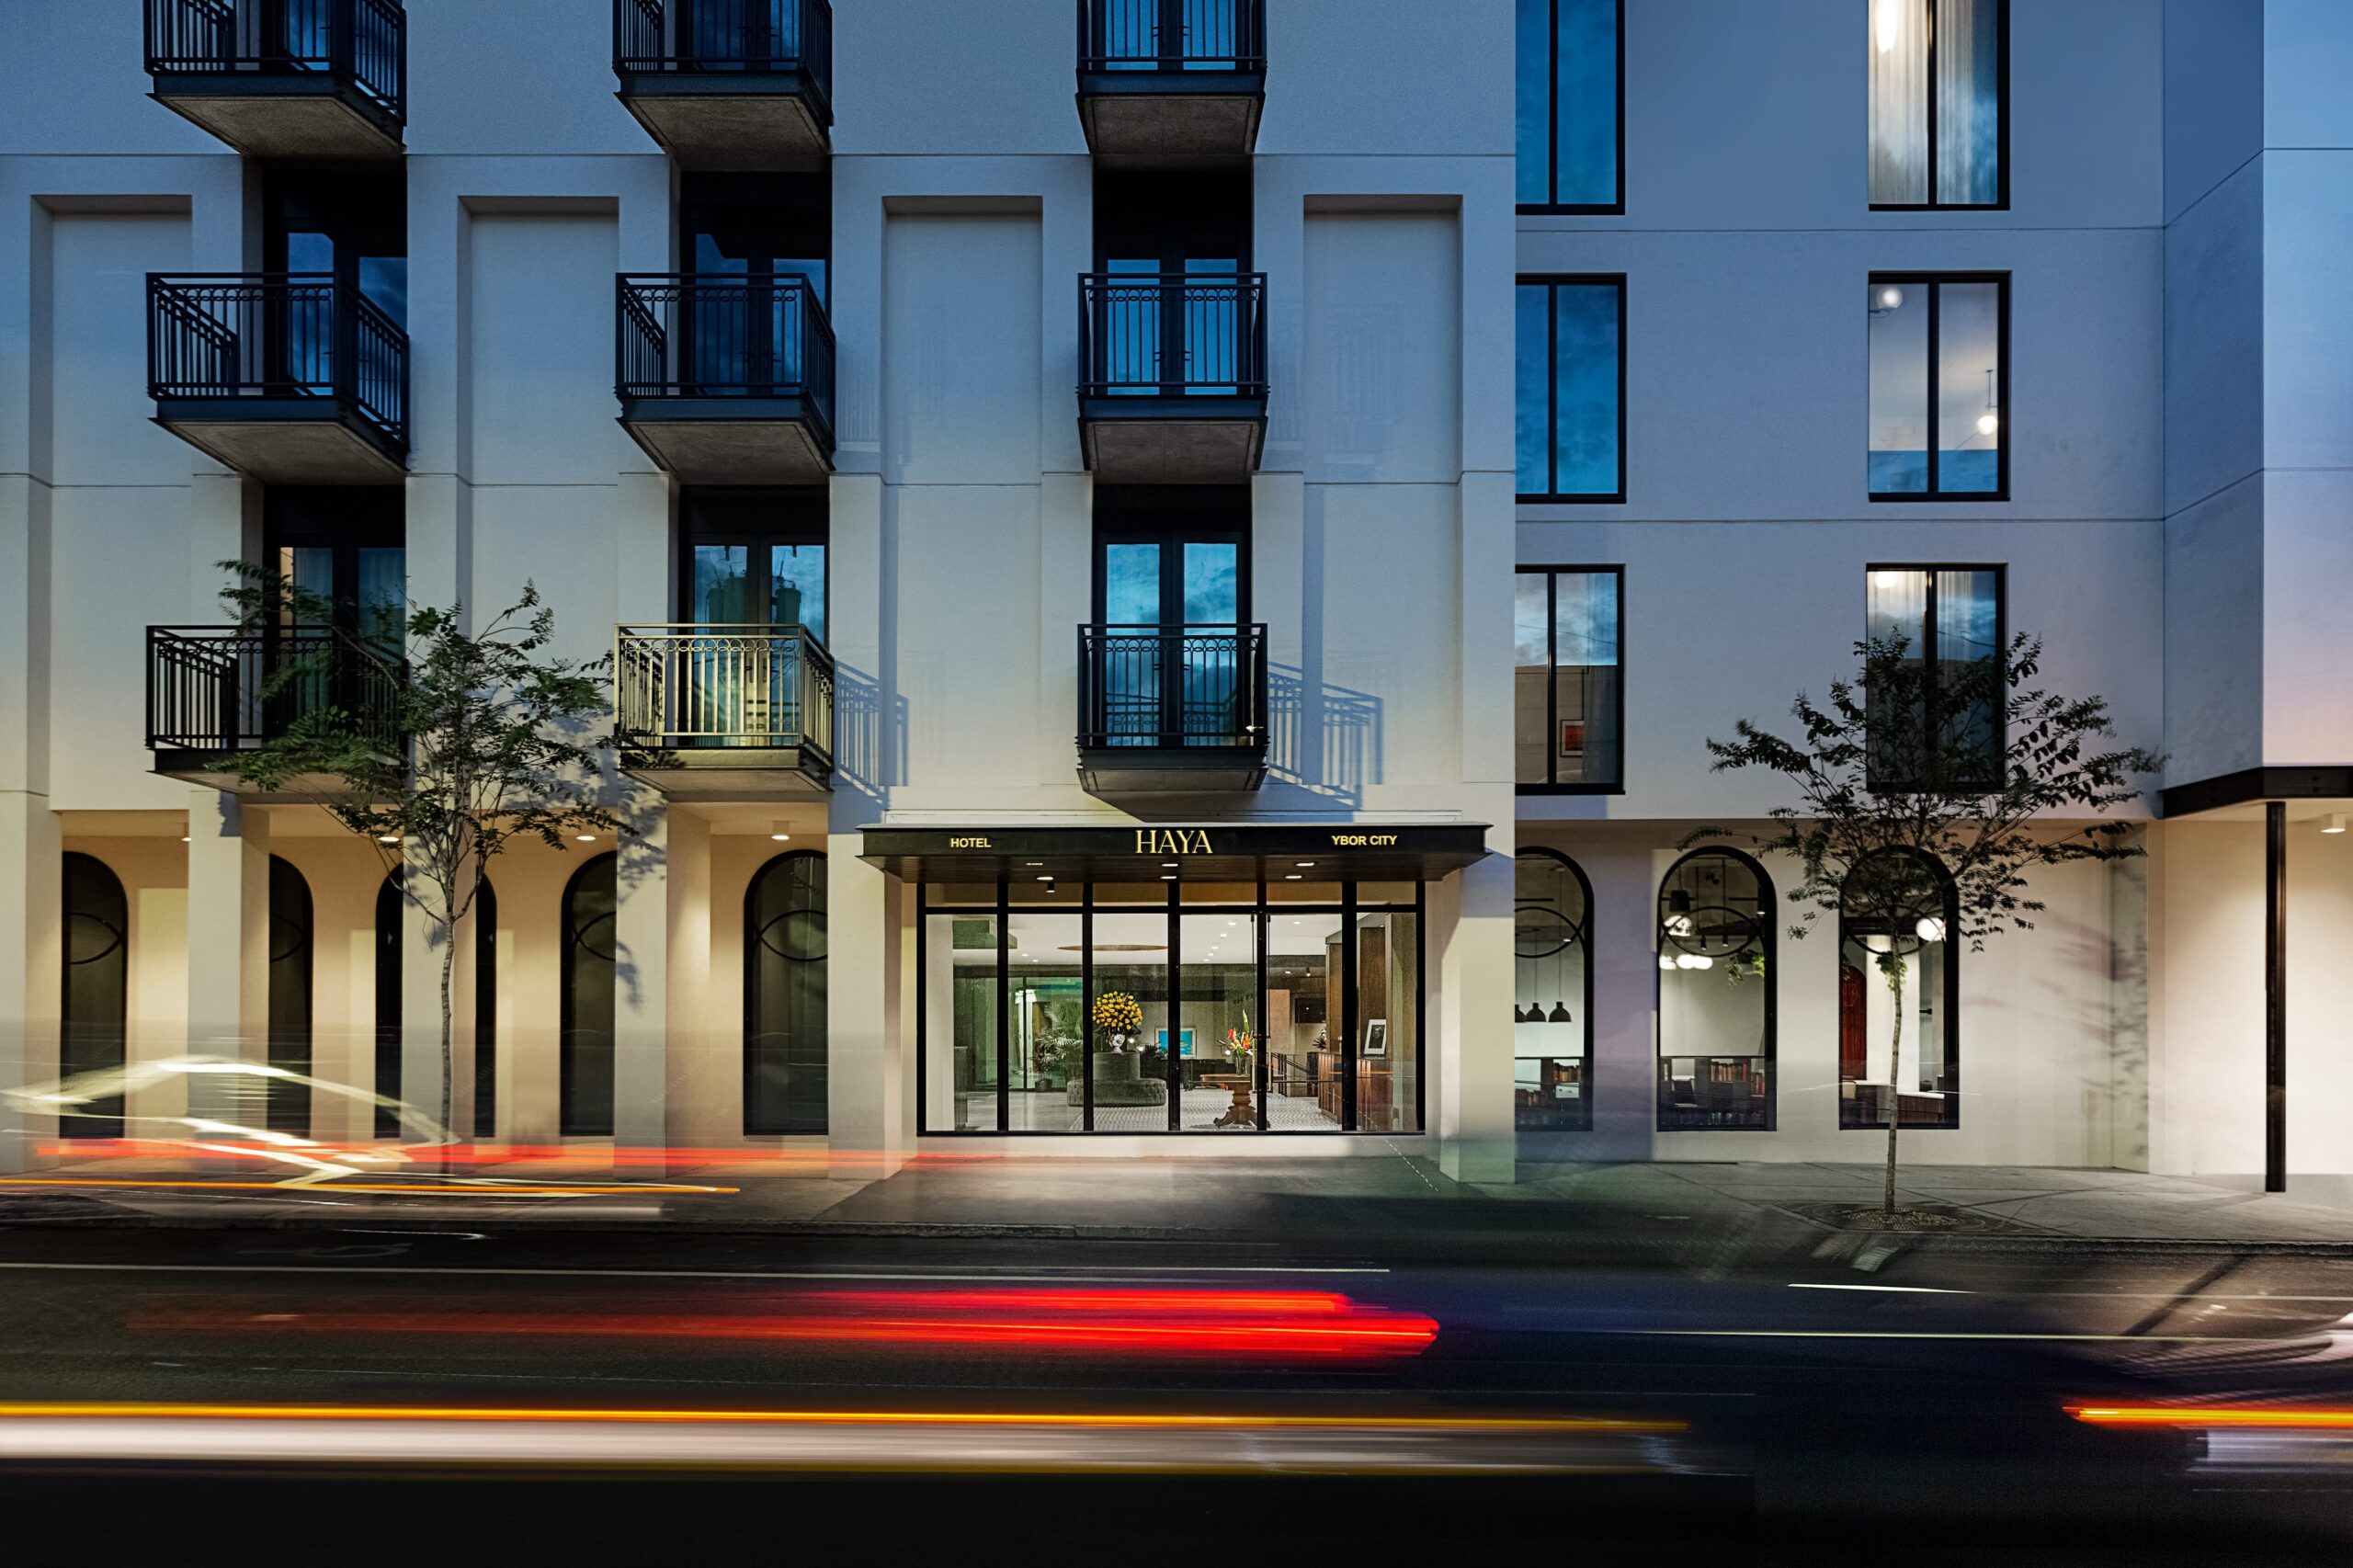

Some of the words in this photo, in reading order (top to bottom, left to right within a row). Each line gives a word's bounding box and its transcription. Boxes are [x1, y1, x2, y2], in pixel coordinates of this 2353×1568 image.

[950, 837, 992, 848] HOTEL
[1135, 830, 1213, 854] HAYA
[1331, 835, 1367, 846] YBOR
[1370, 835, 1398, 846] CITY
